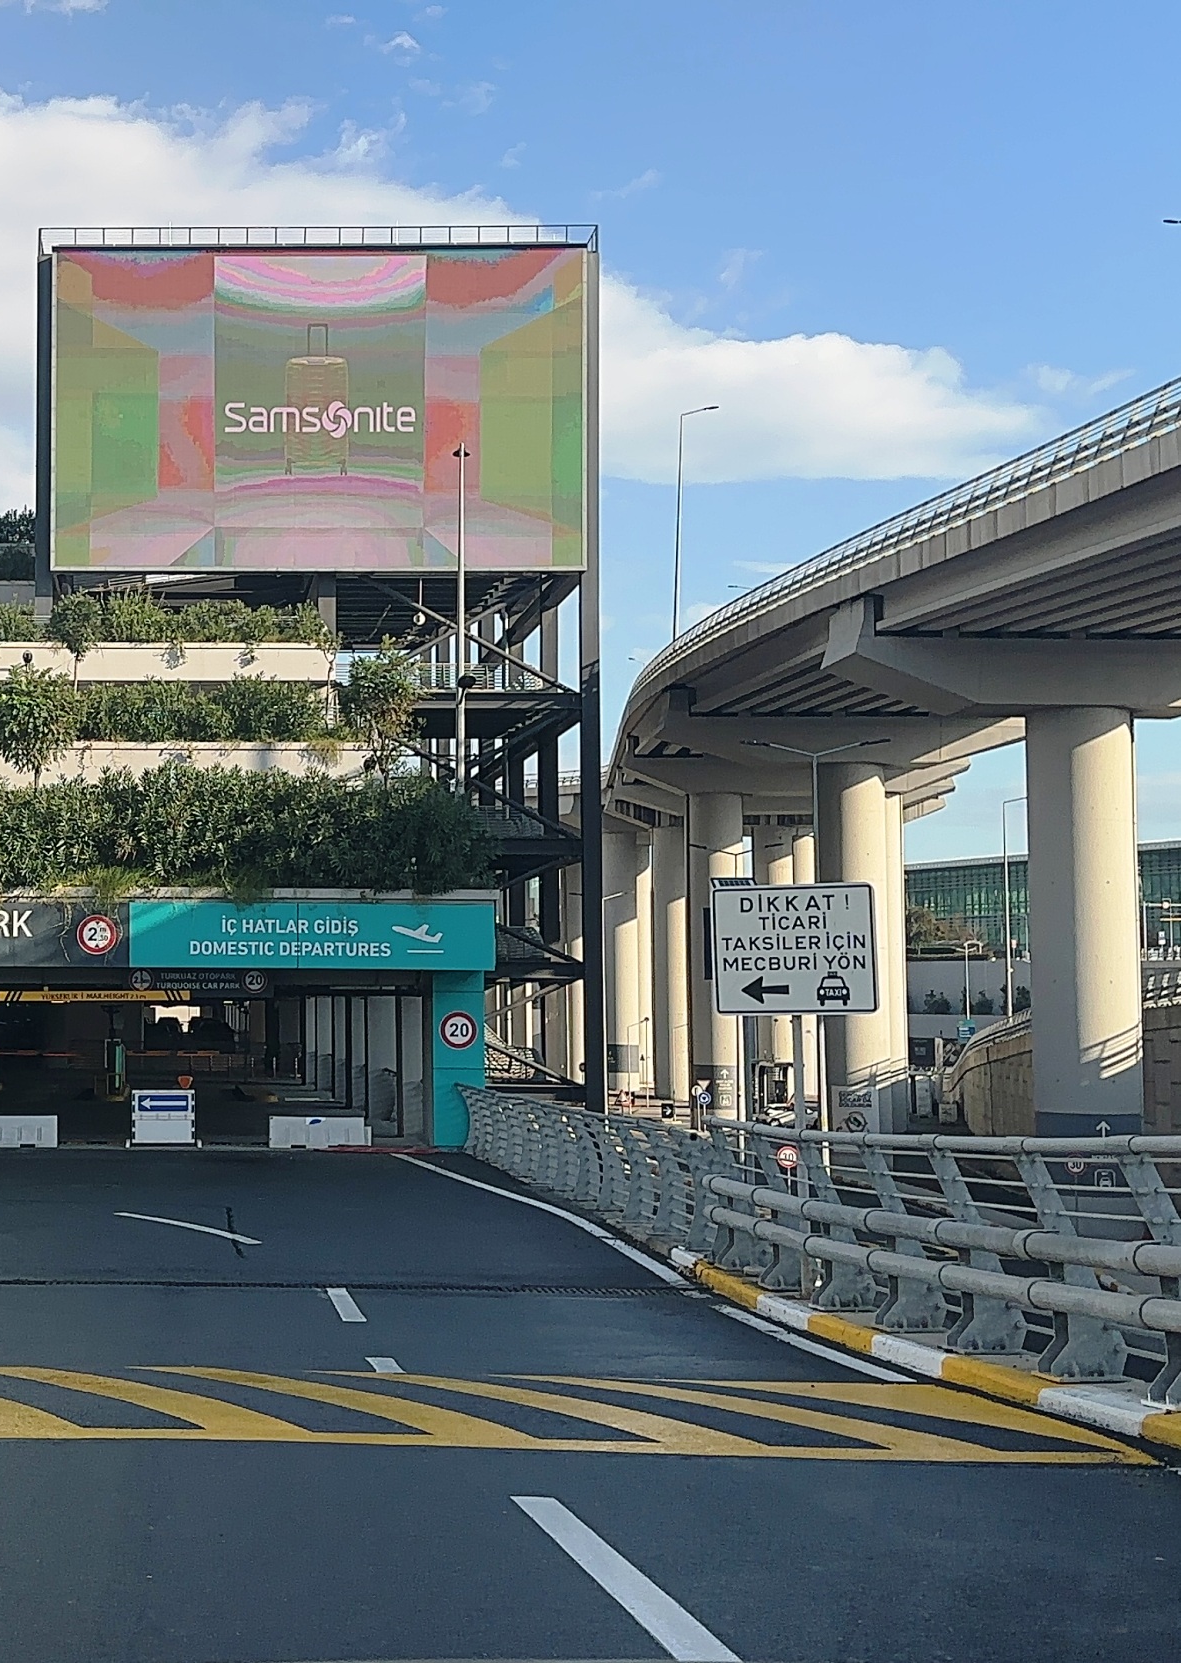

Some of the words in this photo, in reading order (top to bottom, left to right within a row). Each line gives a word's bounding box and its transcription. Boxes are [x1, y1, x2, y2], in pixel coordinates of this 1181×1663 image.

[224, 400, 416, 438] Samsonite
[739, 893, 835, 913] DİKKAT
[221, 914, 237, 936] İÇ
[242, 918, 309, 934] HATLAR
[314, 914, 359, 936] GİDİŞ
[759, 912, 827, 931] TİCARİ
[189, 940, 274, 957] DOMESTIC
[279, 940, 392, 958] DEPARTURES
[721, 933, 821, 951] TAKSİLER
[826, 932, 866, 951] İÇİN
[723, 953, 817, 972] MECBURİ
[823, 951, 866, 970] YÖN
[160, 972, 196, 980] TURKUAZ
[198, 972, 236, 980] OTOPARK
[247, 974, 262, 986] 20
[156, 982, 201, 990] TURQUOISE
[824, 987, 843, 996] TAXI
[449, 1021, 470, 1039] 20
